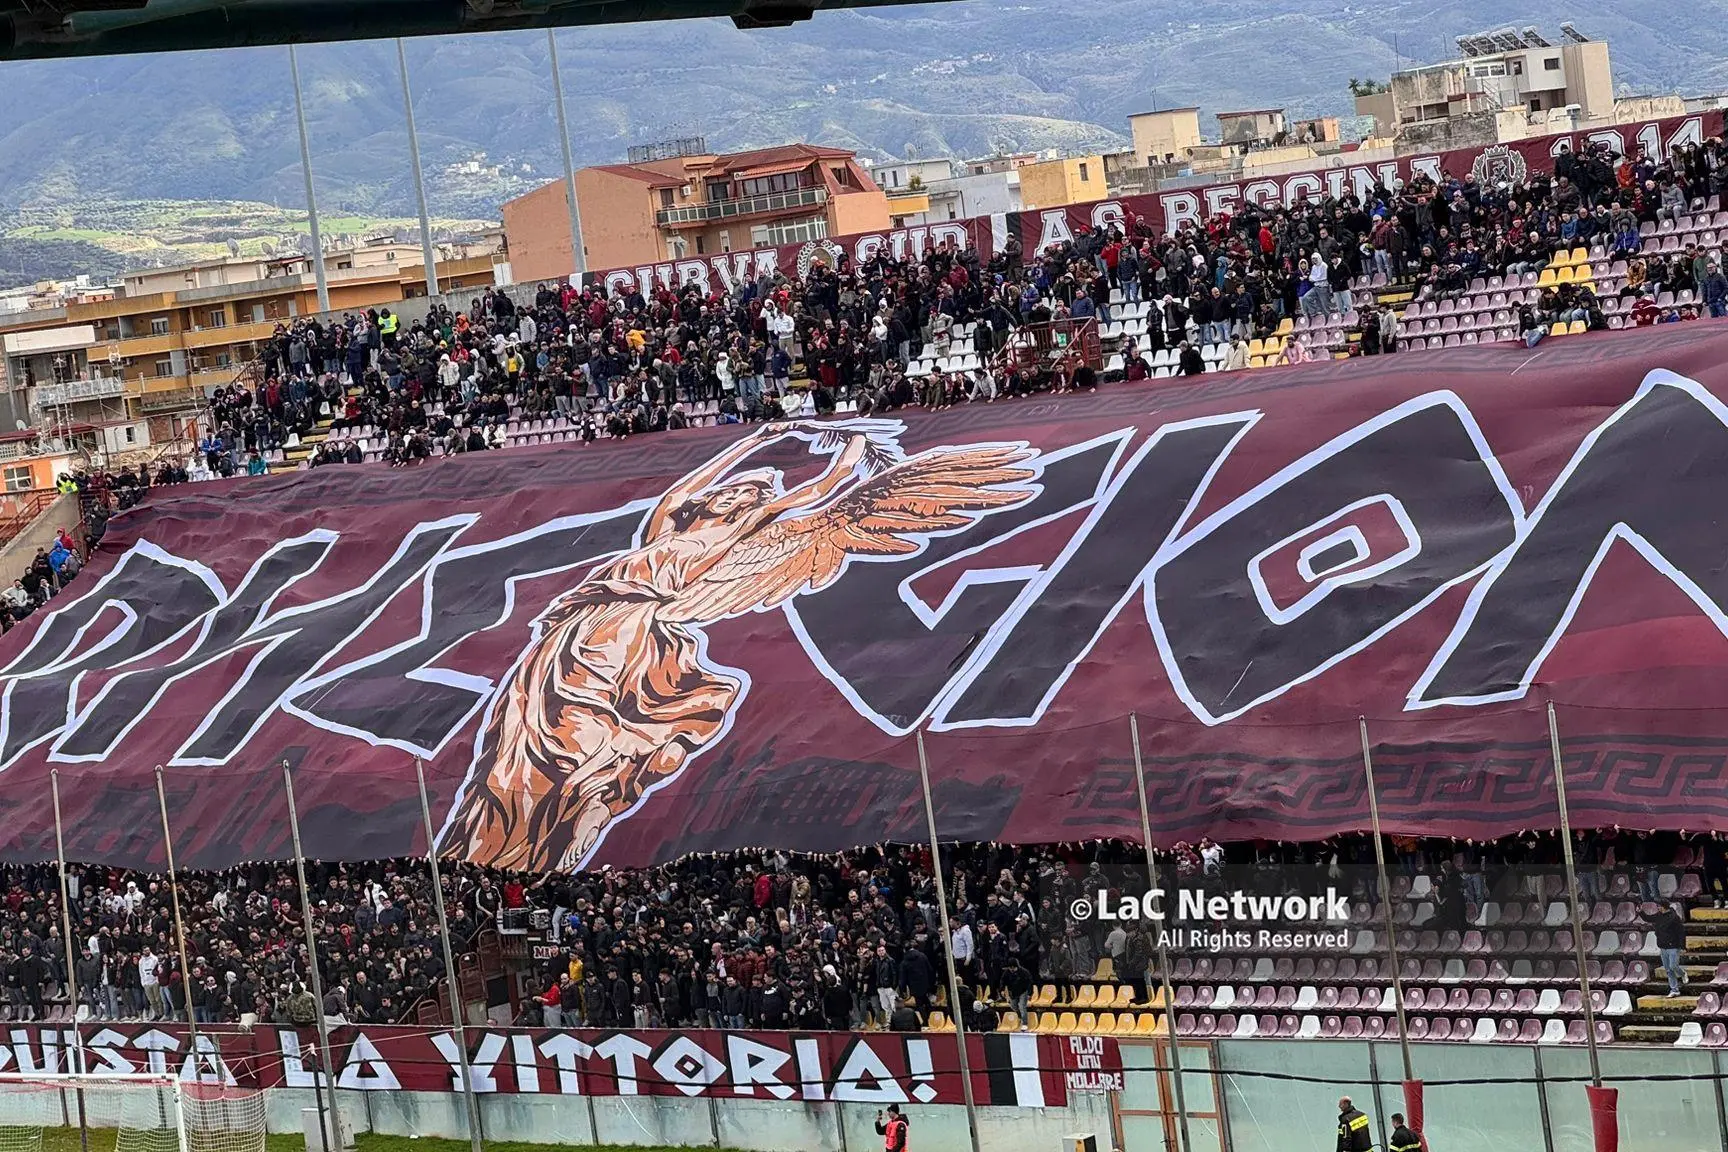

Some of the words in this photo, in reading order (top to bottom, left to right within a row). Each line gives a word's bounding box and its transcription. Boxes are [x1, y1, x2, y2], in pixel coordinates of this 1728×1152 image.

[0, 1028, 238, 1087] UISTA
[278, 1029, 402, 1090] LA
[429, 1031, 936, 1103] VITTORIA!
[1065, 1071, 1123, 1091] MOLLARE
